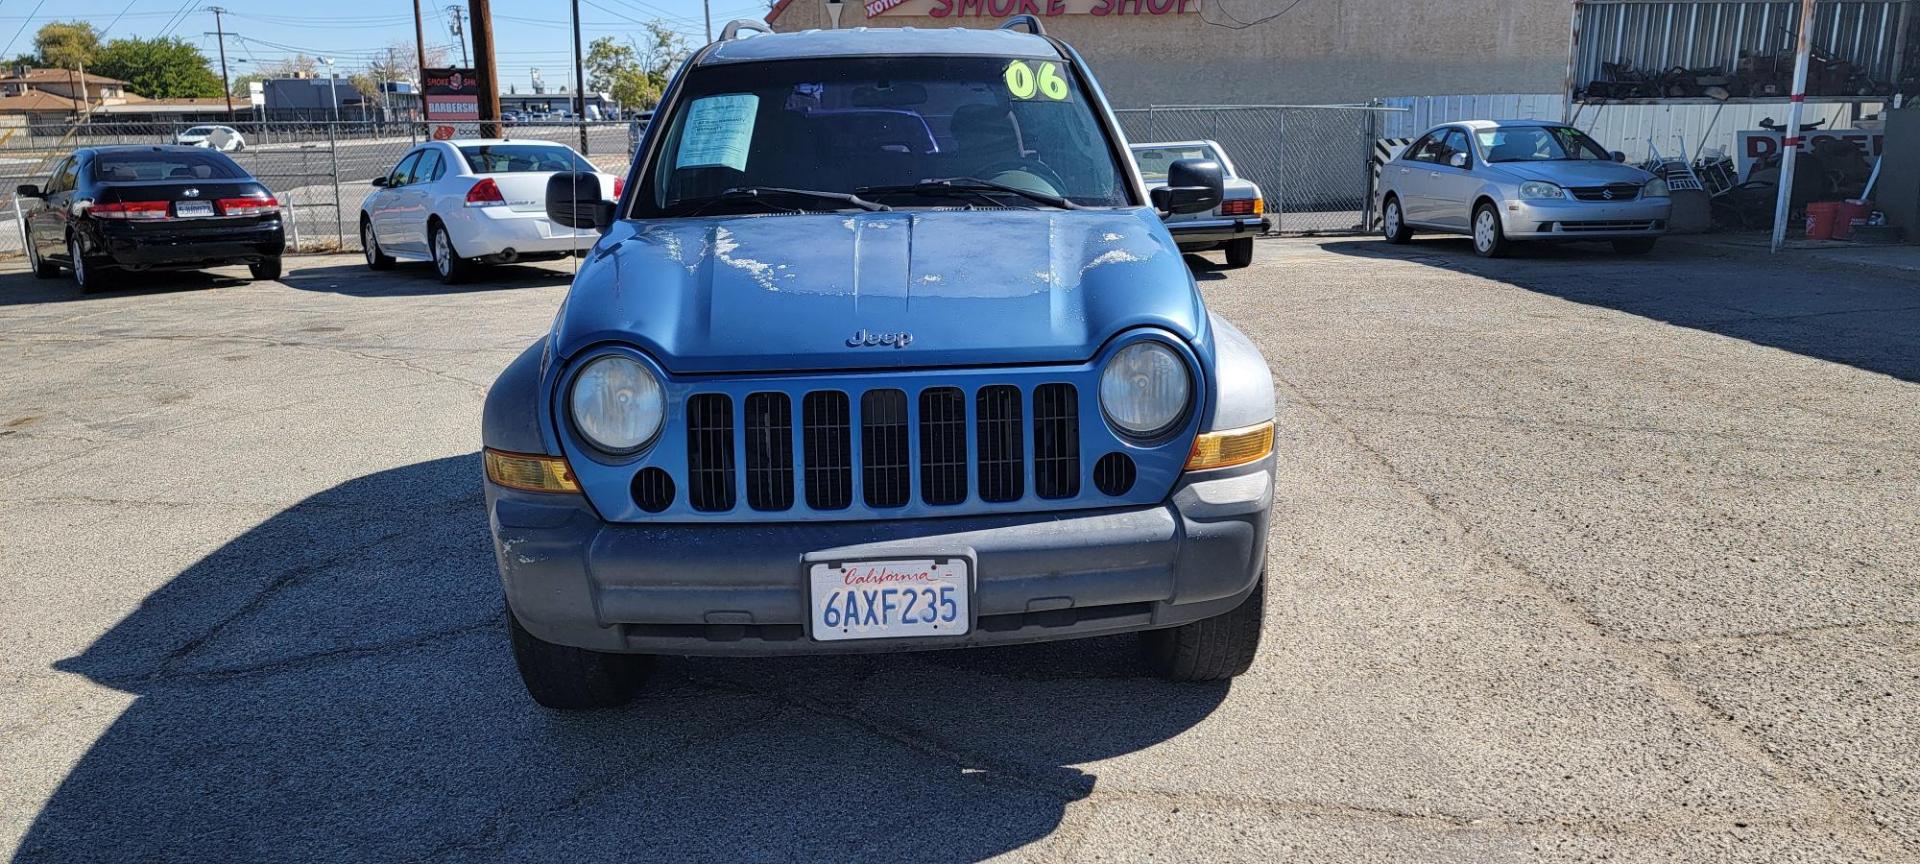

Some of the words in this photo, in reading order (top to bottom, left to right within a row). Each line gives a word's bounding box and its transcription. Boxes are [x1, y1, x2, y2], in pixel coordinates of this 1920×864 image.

[929, 0, 1066, 17] SMOKE
[1006, 60, 1068, 99] 06
[846, 329, 913, 349] Jeep
[844, 567, 940, 585] California
[823, 587, 957, 627] 6AXF235
